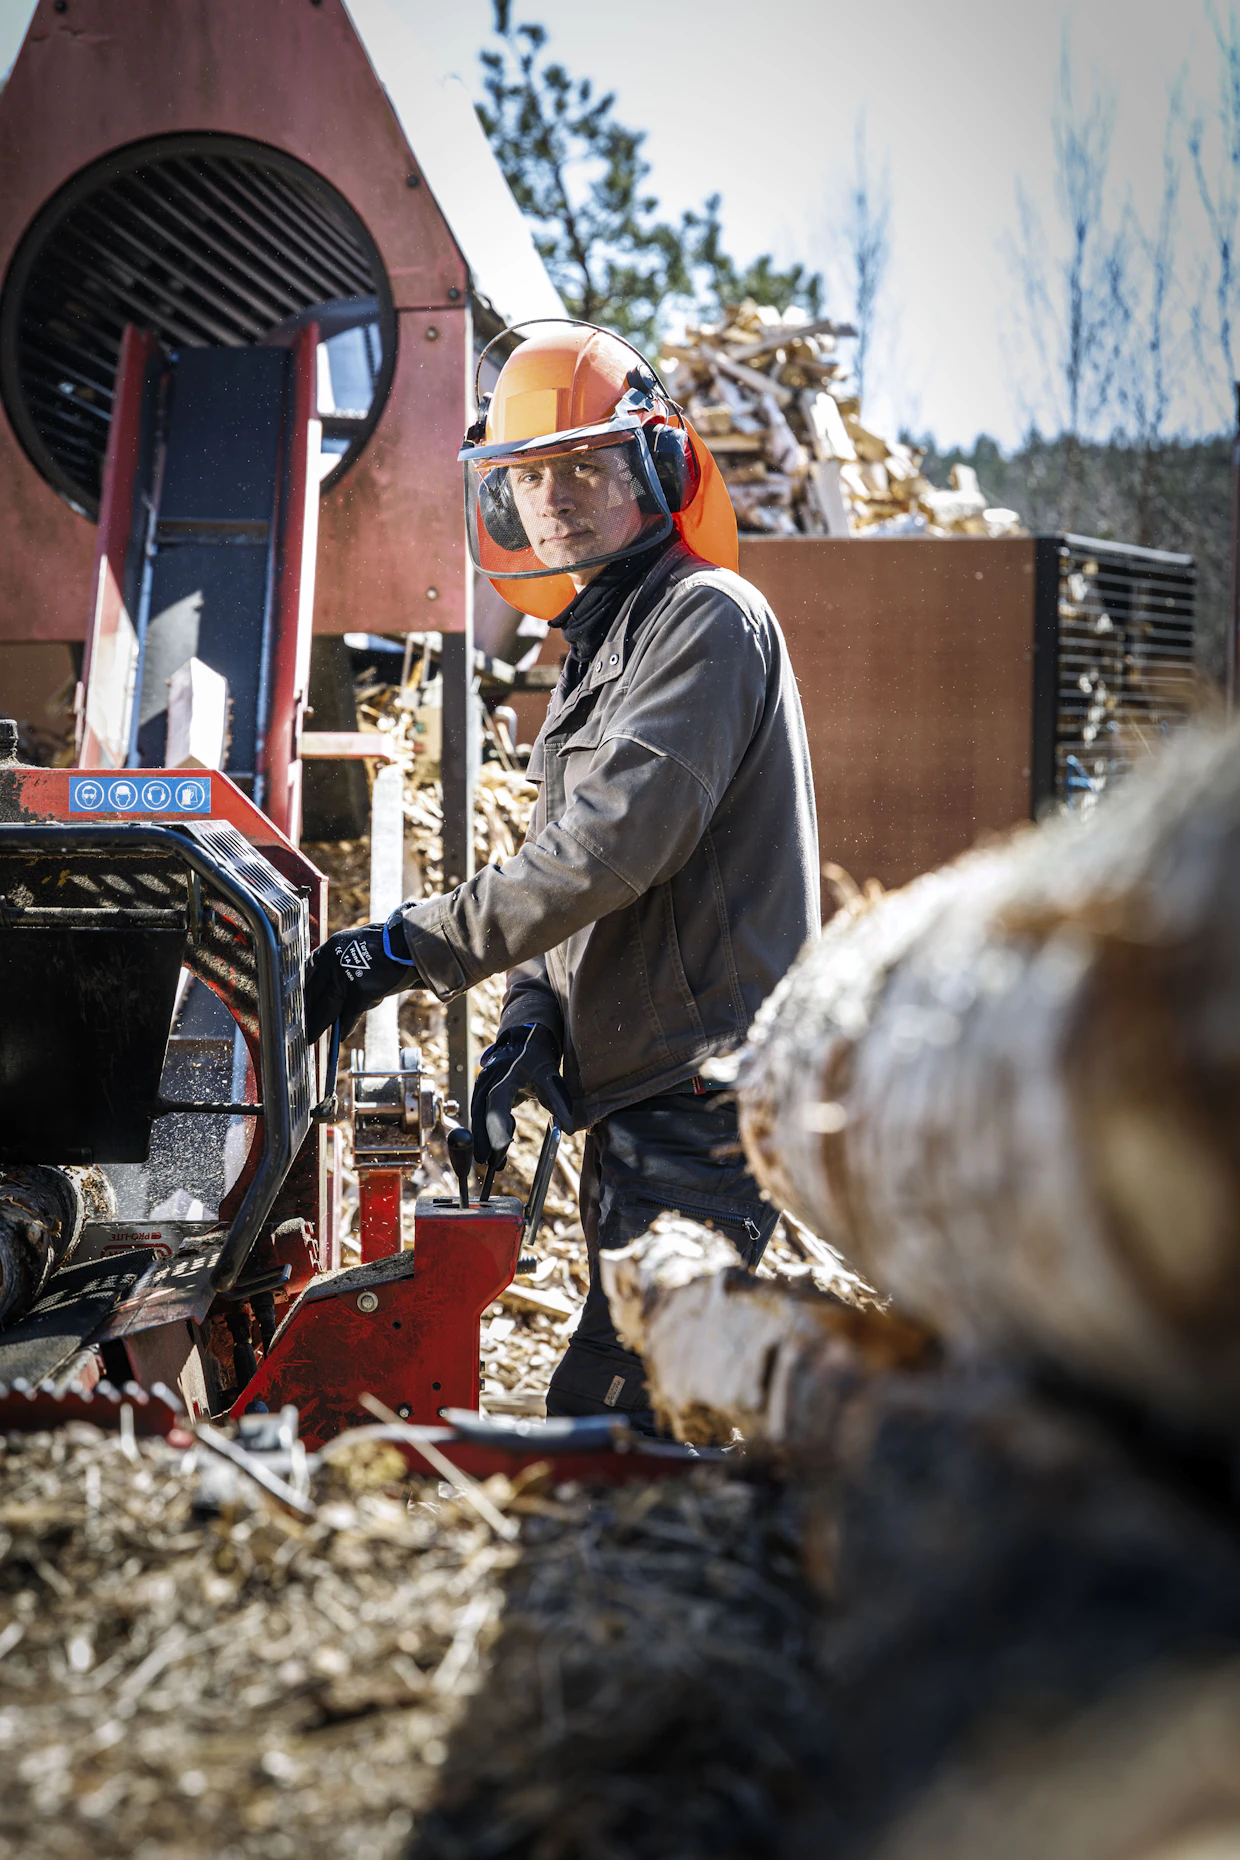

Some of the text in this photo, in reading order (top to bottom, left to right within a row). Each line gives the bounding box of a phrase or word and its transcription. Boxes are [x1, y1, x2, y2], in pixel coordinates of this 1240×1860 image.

[349, 947, 361, 965] Hand
[360, 941, 373, 961] Target
[111, 1232, 151, 1240] PRO-LITE
